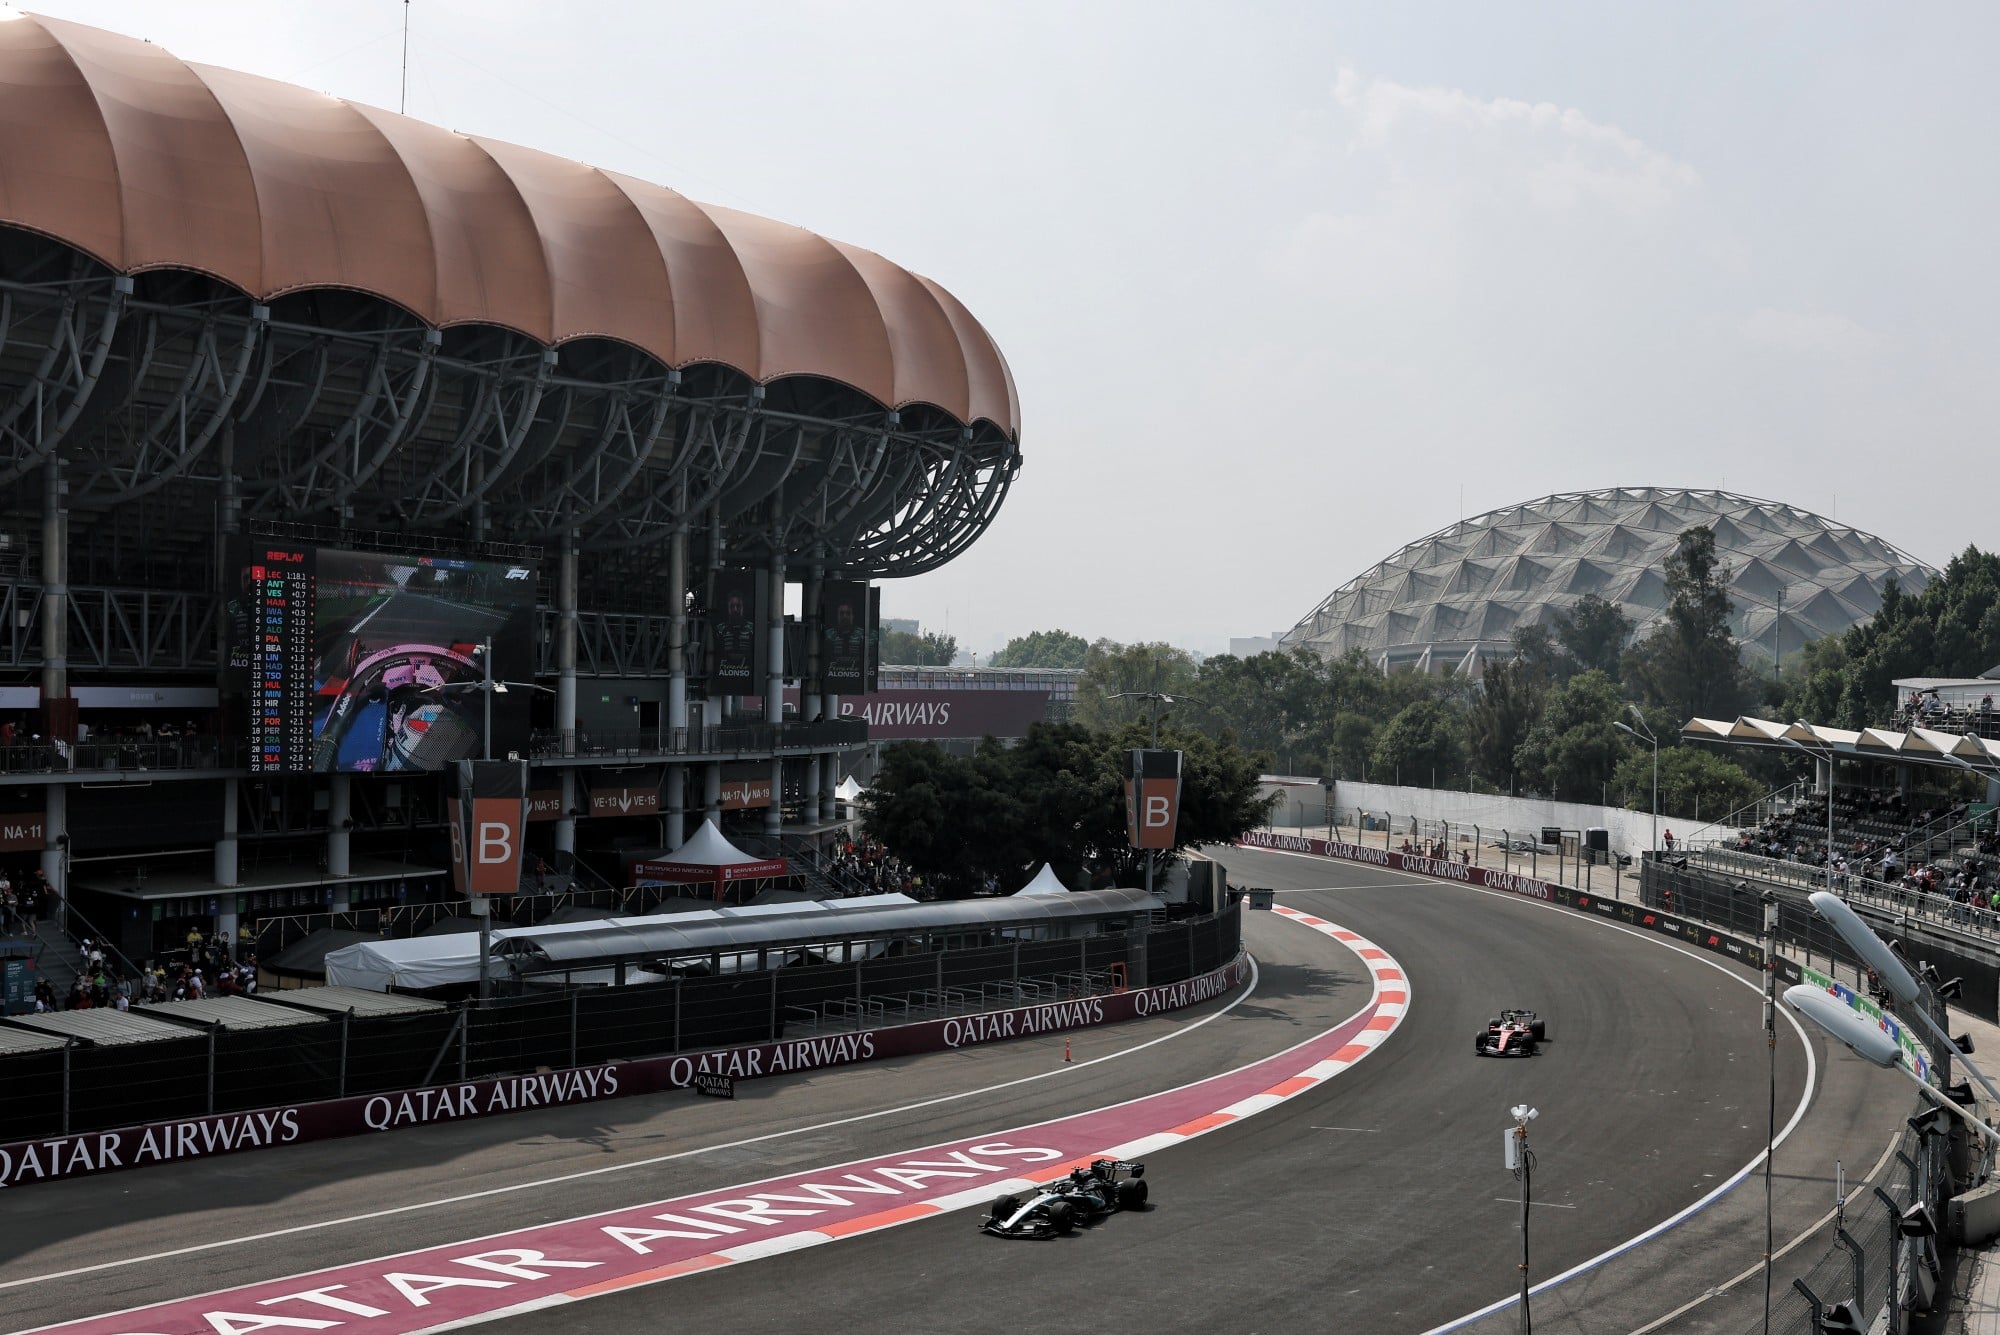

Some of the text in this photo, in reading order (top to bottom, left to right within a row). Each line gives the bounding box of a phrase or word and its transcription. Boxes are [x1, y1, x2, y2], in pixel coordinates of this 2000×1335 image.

[266, 552, 304, 562] REPLAY
[718, 669, 750, 678] ALONSO
[828, 670, 860, 678] ALONSO
[861, 702, 951, 726] AIRWAYS
[1146, 796, 1170, 828] B
[450, 822, 462, 864] B
[478, 822, 512, 864] B
[1242, 830, 1312, 852] QATAR AIRWAYS
[1324, 840, 1389, 866] QATAR AIRWAYS
[645, 865, 682, 873] SERVICIO
[1402, 854, 1470, 880] QATAR AIRWAYS
[1484, 870, 1513, 890] QATAR
[1515, 878, 1548, 898] AIRWAYS
[1134, 984, 1188, 1016] QATAR
[1189, 970, 1227, 1004] AIRWAYS
[943, 998, 1104, 1048] QATAR AIRWAYS
[670, 1032, 875, 1088] QATAR AIRWAYS
[698, 1075, 730, 1089] QATAR
[705, 1087, 731, 1097] AIRWAYS
[364, 1066, 619, 1132] QATAR AIRWAYS
[134, 1108, 300, 1164] AIRWAYS
[112, 1142, 1064, 1335] ATAR AIRWAYS
